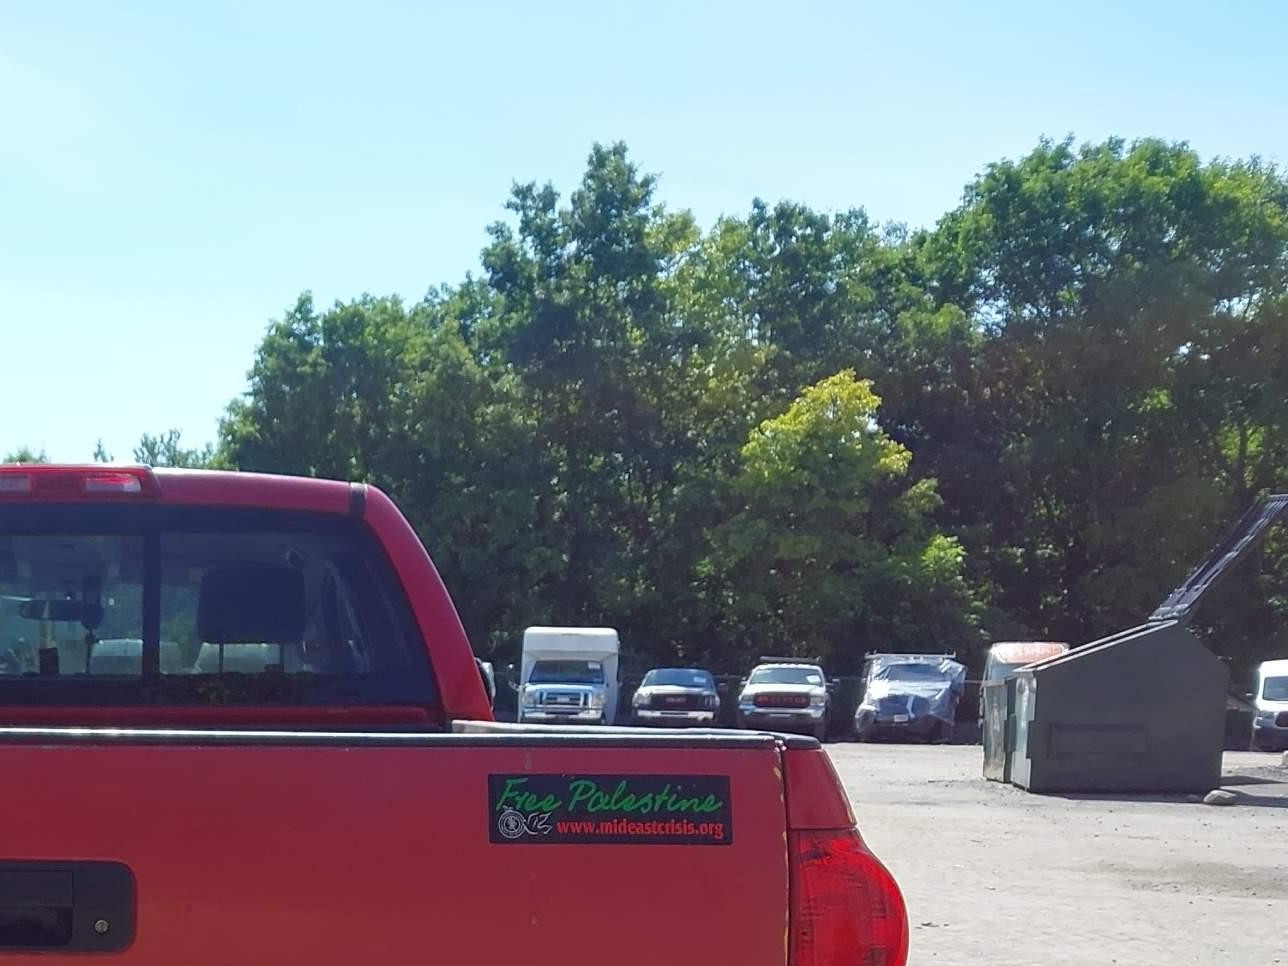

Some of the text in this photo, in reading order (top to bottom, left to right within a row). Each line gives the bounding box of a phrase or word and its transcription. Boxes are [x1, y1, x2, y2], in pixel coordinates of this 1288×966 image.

[496, 778, 723, 813] Free Palestine
[557, 818, 724, 839] www.mideastcrisis.org
